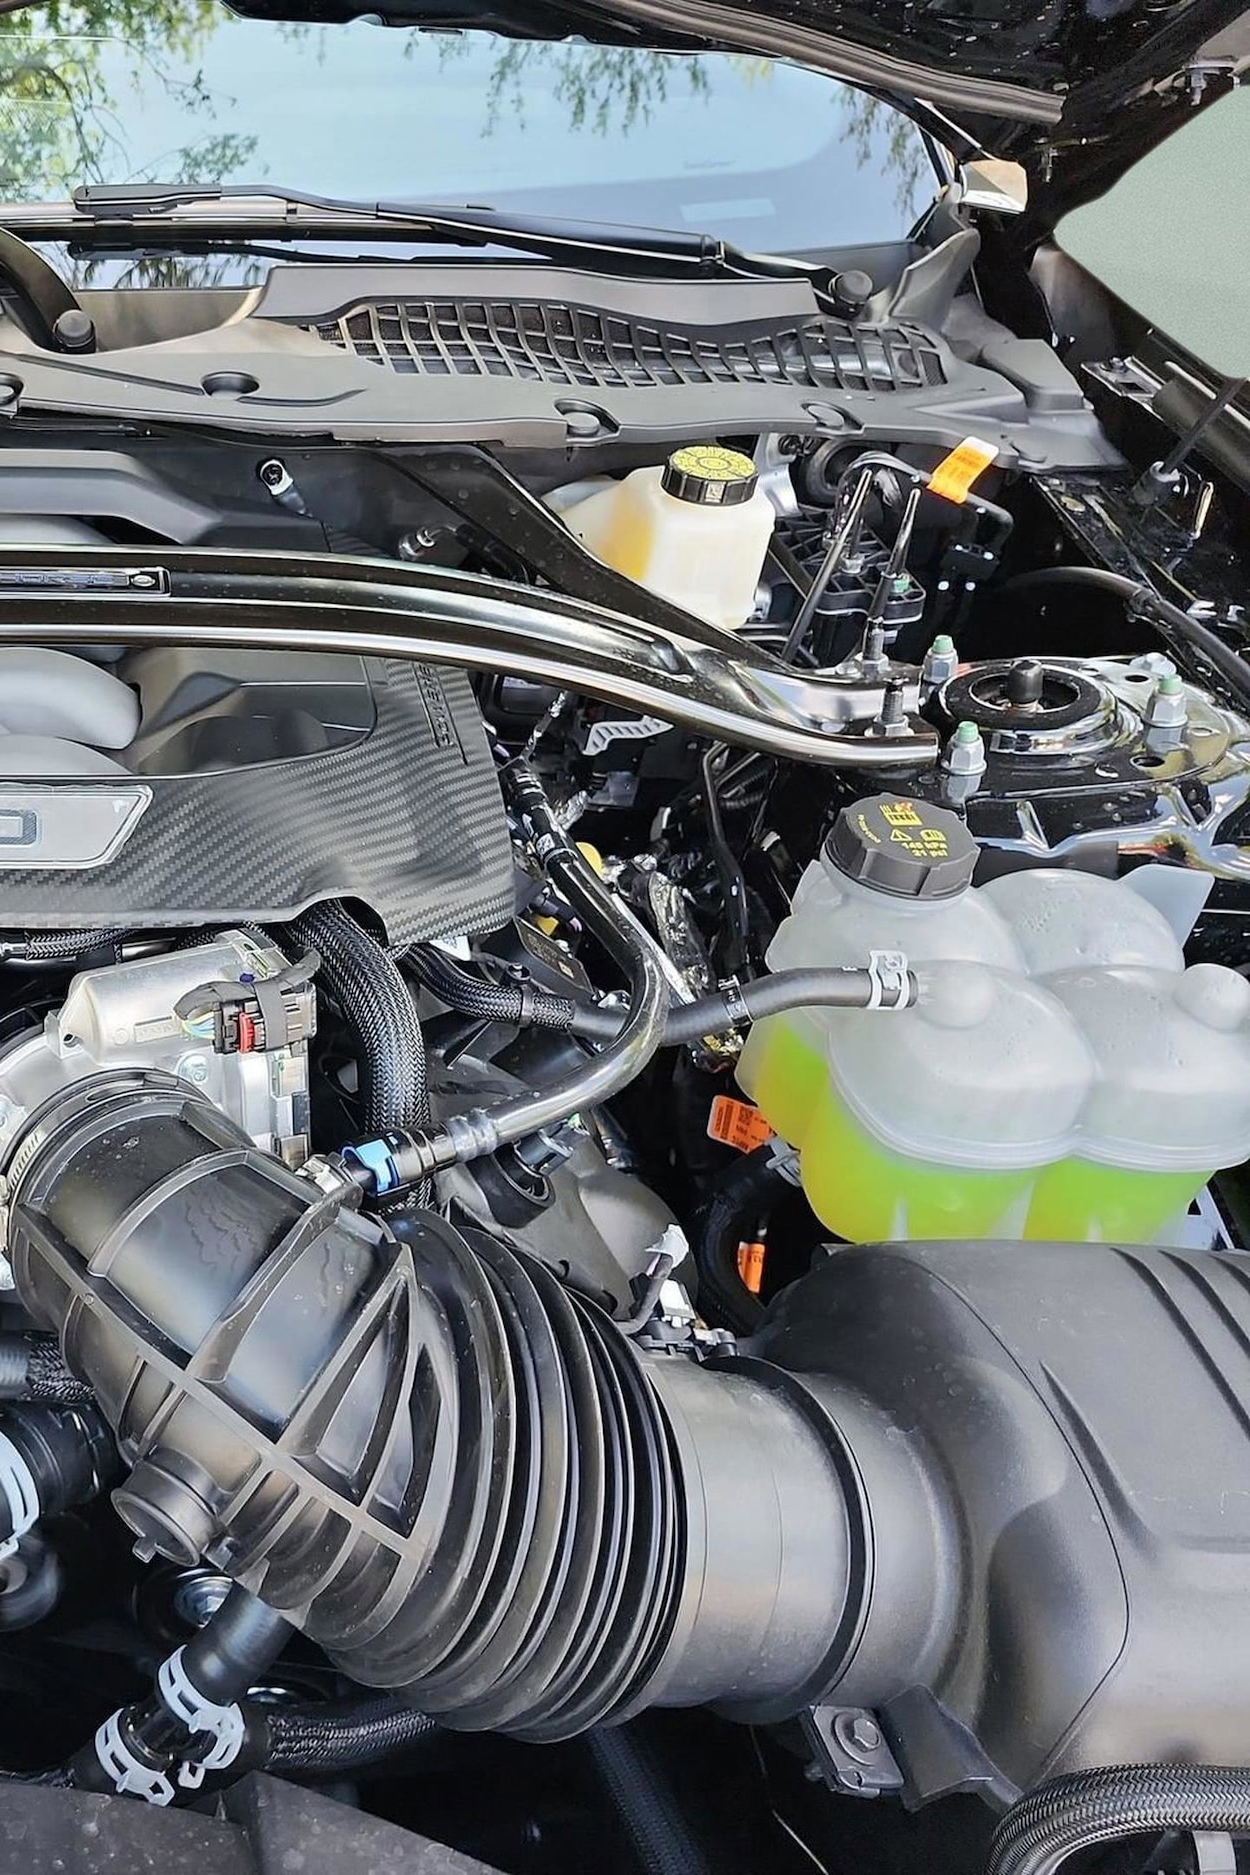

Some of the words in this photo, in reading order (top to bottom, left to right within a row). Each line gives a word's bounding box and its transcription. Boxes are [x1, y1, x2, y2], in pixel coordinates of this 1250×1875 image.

[923, 841, 948, 850] kPa
[911, 849, 927, 857] 21
[929, 849, 949, 858] psi
